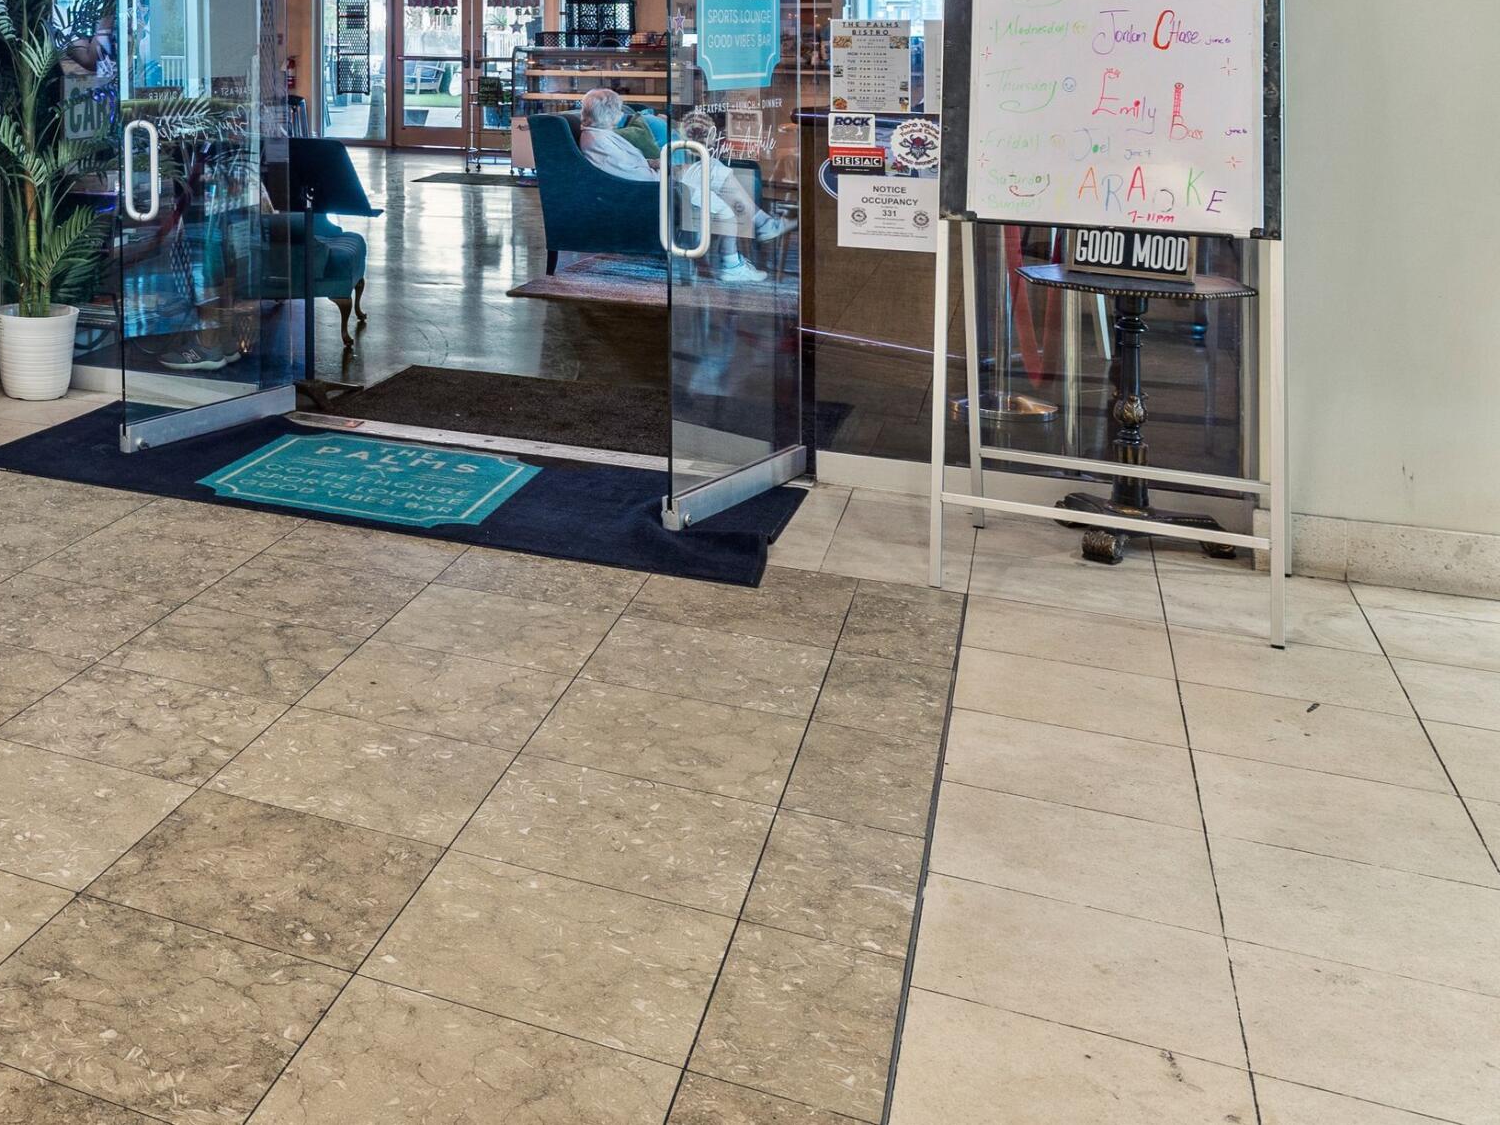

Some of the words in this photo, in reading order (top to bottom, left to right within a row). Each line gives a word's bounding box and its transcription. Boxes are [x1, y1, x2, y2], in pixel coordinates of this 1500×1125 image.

[434, 8, 458, 16] BAR
[515, 8, 541, 16] BAR
[707, 9, 739, 24] SPORTS
[740, 9, 772, 24] LOUNGE
[1092, 9, 1147, 55] Jordan
[707, 34, 733, 48] GOOD
[734, 34, 756, 48] VIBES
[757, 34, 772, 47] BAR
[694, 102, 730, 115] BREAKFAST
[761, 98, 783, 110] DINNER
[1092, 68, 1157, 135] Emily
[834, 117, 871, 126] ROCK
[705, 125, 733, 166] Stay
[835, 157, 880, 166] SESAC
[873, 185, 907, 194] NOTICE
[861, 196, 918, 206] OCCUPANCY
[882, 209, 897, 217] 331
[1076, 229, 1125, 265] GOOD
[1132, 233, 1189, 271] MOOD
[315, 446, 480, 474] PALMS
[381, 447, 438, 460] THE
[265, 463, 474, 496] COFFEEHOUSE
[239, 478, 316, 495] GOOD
[328, 491, 394, 506] VIBES
[404, 502, 453, 513] BAR
[252, 471, 349, 490] SPORTS
[359, 485, 464, 506] LOUNGE
